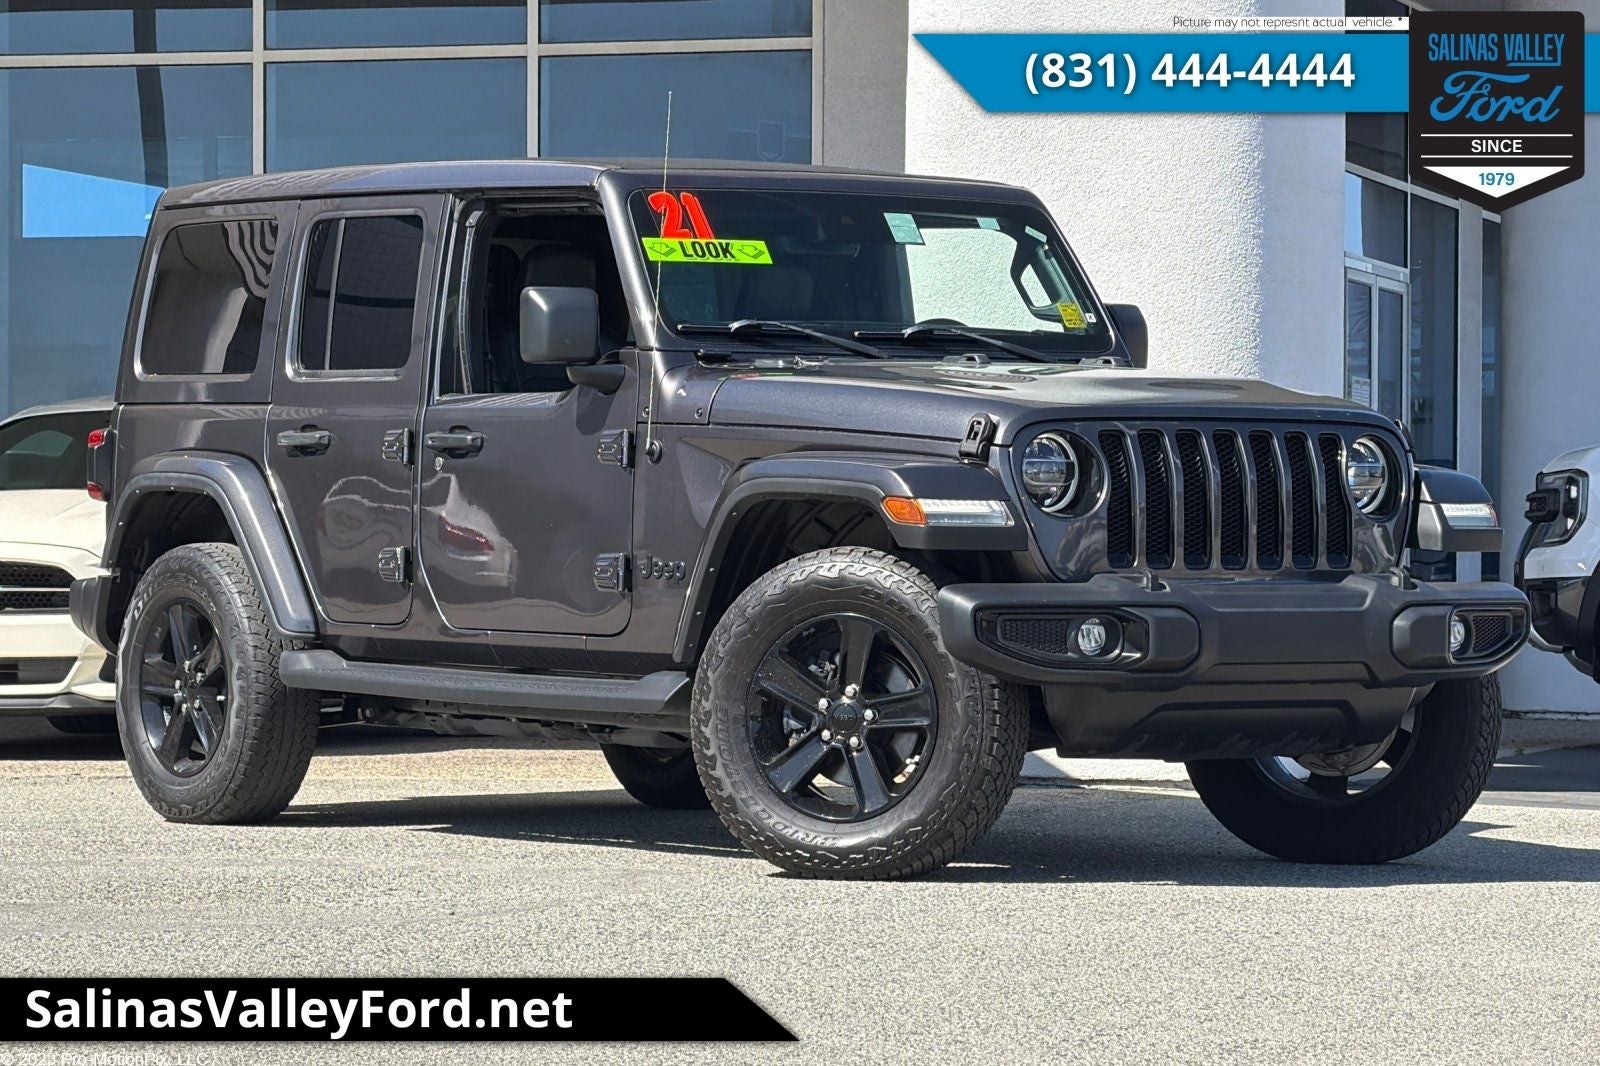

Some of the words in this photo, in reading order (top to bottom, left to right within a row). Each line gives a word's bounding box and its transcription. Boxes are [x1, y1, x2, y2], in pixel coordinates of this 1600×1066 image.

[648, 191, 715, 240] 21
[678, 240, 737, 260] LOOK
[640, 553, 687, 586] Jeep
